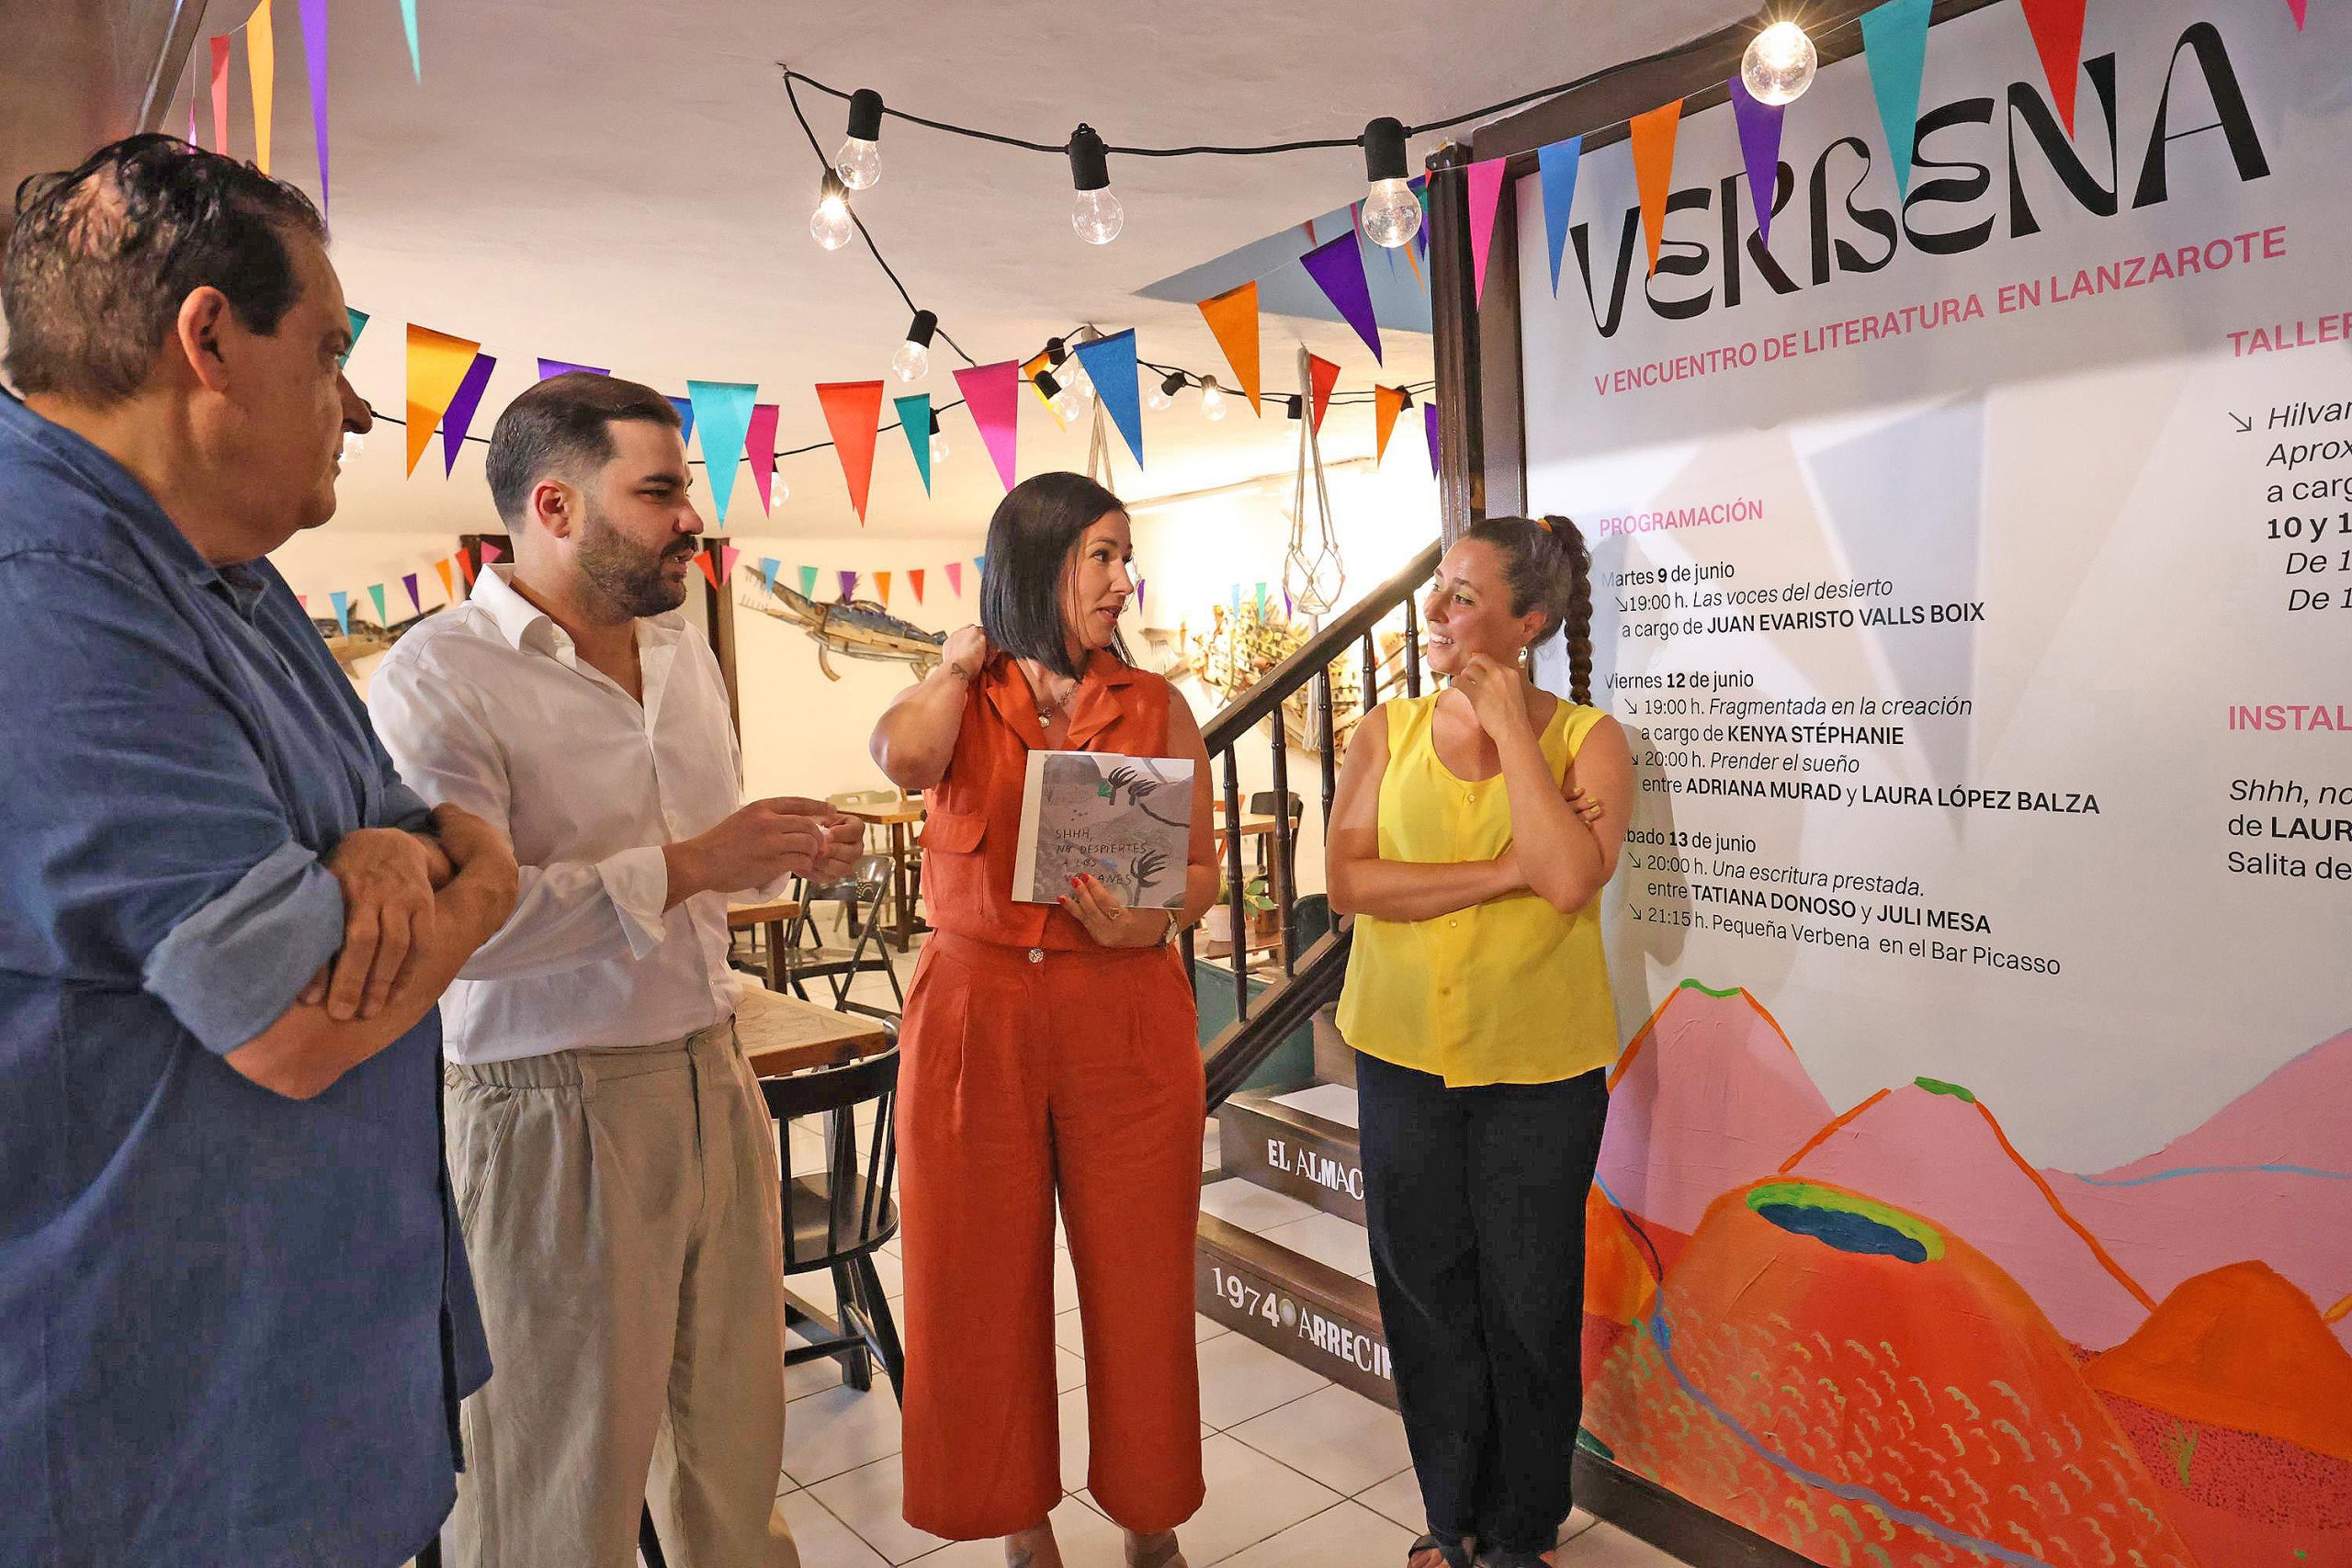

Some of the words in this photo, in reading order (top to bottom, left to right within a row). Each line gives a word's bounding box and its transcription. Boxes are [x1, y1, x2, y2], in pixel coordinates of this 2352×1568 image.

[1569, 21, 2271, 339] VERBENA
[1594, 374, 1610, 396] V
[1614, 343, 1758, 393] ENCUENTRO
[1763, 333, 1797, 362] DE
[1804, 294, 1984, 355] LITERATURA
[1997, 279, 2041, 314] EN
[2051, 225, 2287, 304] LANZAROTE
[2267, 484, 2283, 502] a
[1599, 497, 1764, 537] PROGRAMACIÓN
[2267, 516, 2302, 539] 10
[2309, 516, 2329, 544] y
[1601, 566, 1655, 589] Martes
[1657, 567, 1668, 583] 9
[1671, 565, 1691, 582] de
[1693, 561, 1735, 585] junio
[2286, 552, 2327, 574] De
[1630, 593, 1671, 612] 19:00
[1675, 591, 1689, 609] h.
[1693, 591, 1722, 608] Las
[1726, 588, 1779, 605] voces
[1782, 582, 1811, 603] del
[1814, 578, 1894, 600] desierto
[2289, 589, 2330, 611] De
[1622, 625, 1631, 637] a
[1634, 622, 1679, 641] cargo
[1683, 617, 1703, 635] de
[1707, 615, 1756, 635] JUAN
[1759, 609, 1855, 632] EVARISTO
[1859, 605, 1926, 626] VALLS
[1930, 602, 1985, 624] BOIX
[1604, 672, 1663, 689] Viernes
[1667, 672, 1686, 689] 12
[1690, 671, 1710, 688] de
[1713, 670, 1754, 693] junio
[1645, 699, 1688, 715] 19:00
[1690, 697, 1704, 715] h.
[1710, 695, 1826, 720] Fragmentada
[1831, 700, 1855, 716] en
[1860, 696, 1876, 716] la
[1882, 695, 1973, 716] creación
[2229, 705, 2352, 731] INSTAL
[1641, 727, 1650, 740] a
[1654, 727, 1700, 746] cargo
[1703, 724, 1724, 741] de
[1728, 725, 1788, 743] KENYA
[1791, 722, 1905, 745] STÉPHANIE
[1645, 750, 1689, 767] 20:00
[1691, 750, 1706, 768] h.
[1711, 751, 1780, 771] Prender
[1782, 753, 1799, 772] el
[1802, 754, 1860, 773] sueño
[1642, 777, 1682, 793] entre
[1686, 777, 1767, 797] ADRIANA
[1770, 781, 1842, 801] MURAD
[1847, 787, 1858, 807] y
[1862, 784, 1934, 807] LAURA
[1938, 784, 2011, 809] LÓPEZ
[2018, 791, 2101, 815] BALZA
[2229, 779, 2310, 808] Shhh,
[2228, 814, 2263, 837] de
[1623, 828, 1665, 845] bado
[1669, 832, 1689, 847] 13
[1691, 832, 1713, 849] de
[1715, 833, 1757, 854] junio
[1647, 854, 1690, 873] 20:00
[1694, 857, 1708, 874] h.
[1713, 860, 1746, 879] Una
[1749, 865, 1827, 887] escritura
[1832, 873, 1925, 897] prestada.
[2228, 851, 2307, 878] Salita
[2315, 856, 2352, 881] de
[1647, 882, 1688, 898] entre
[1691, 885, 1768, 908] TATIANA
[1770, 893, 1857, 918] DONOSO
[1860, 905, 1872, 925] y
[1876, 904, 1921, 926] JULI
[1927, 908, 1992, 933] MESA
[1648, 908, 1691, 927] 21:15
[1695, 911, 1709, 929] h.
[1713, 914, 1787, 939] Pequeña
[1791, 923, 1870, 951] Verbena
[1879, 937, 1904, 955] en
[1908, 939, 1926, 958] el
[1931, 941, 1968, 963] Bar
[1973, 946, 2061, 976] Picasso
[1267, 1138, 1290, 1172] EL
[1295, 1148, 1364, 1201] ALMAC
[1211, 1267, 1281, 1327] 1974
